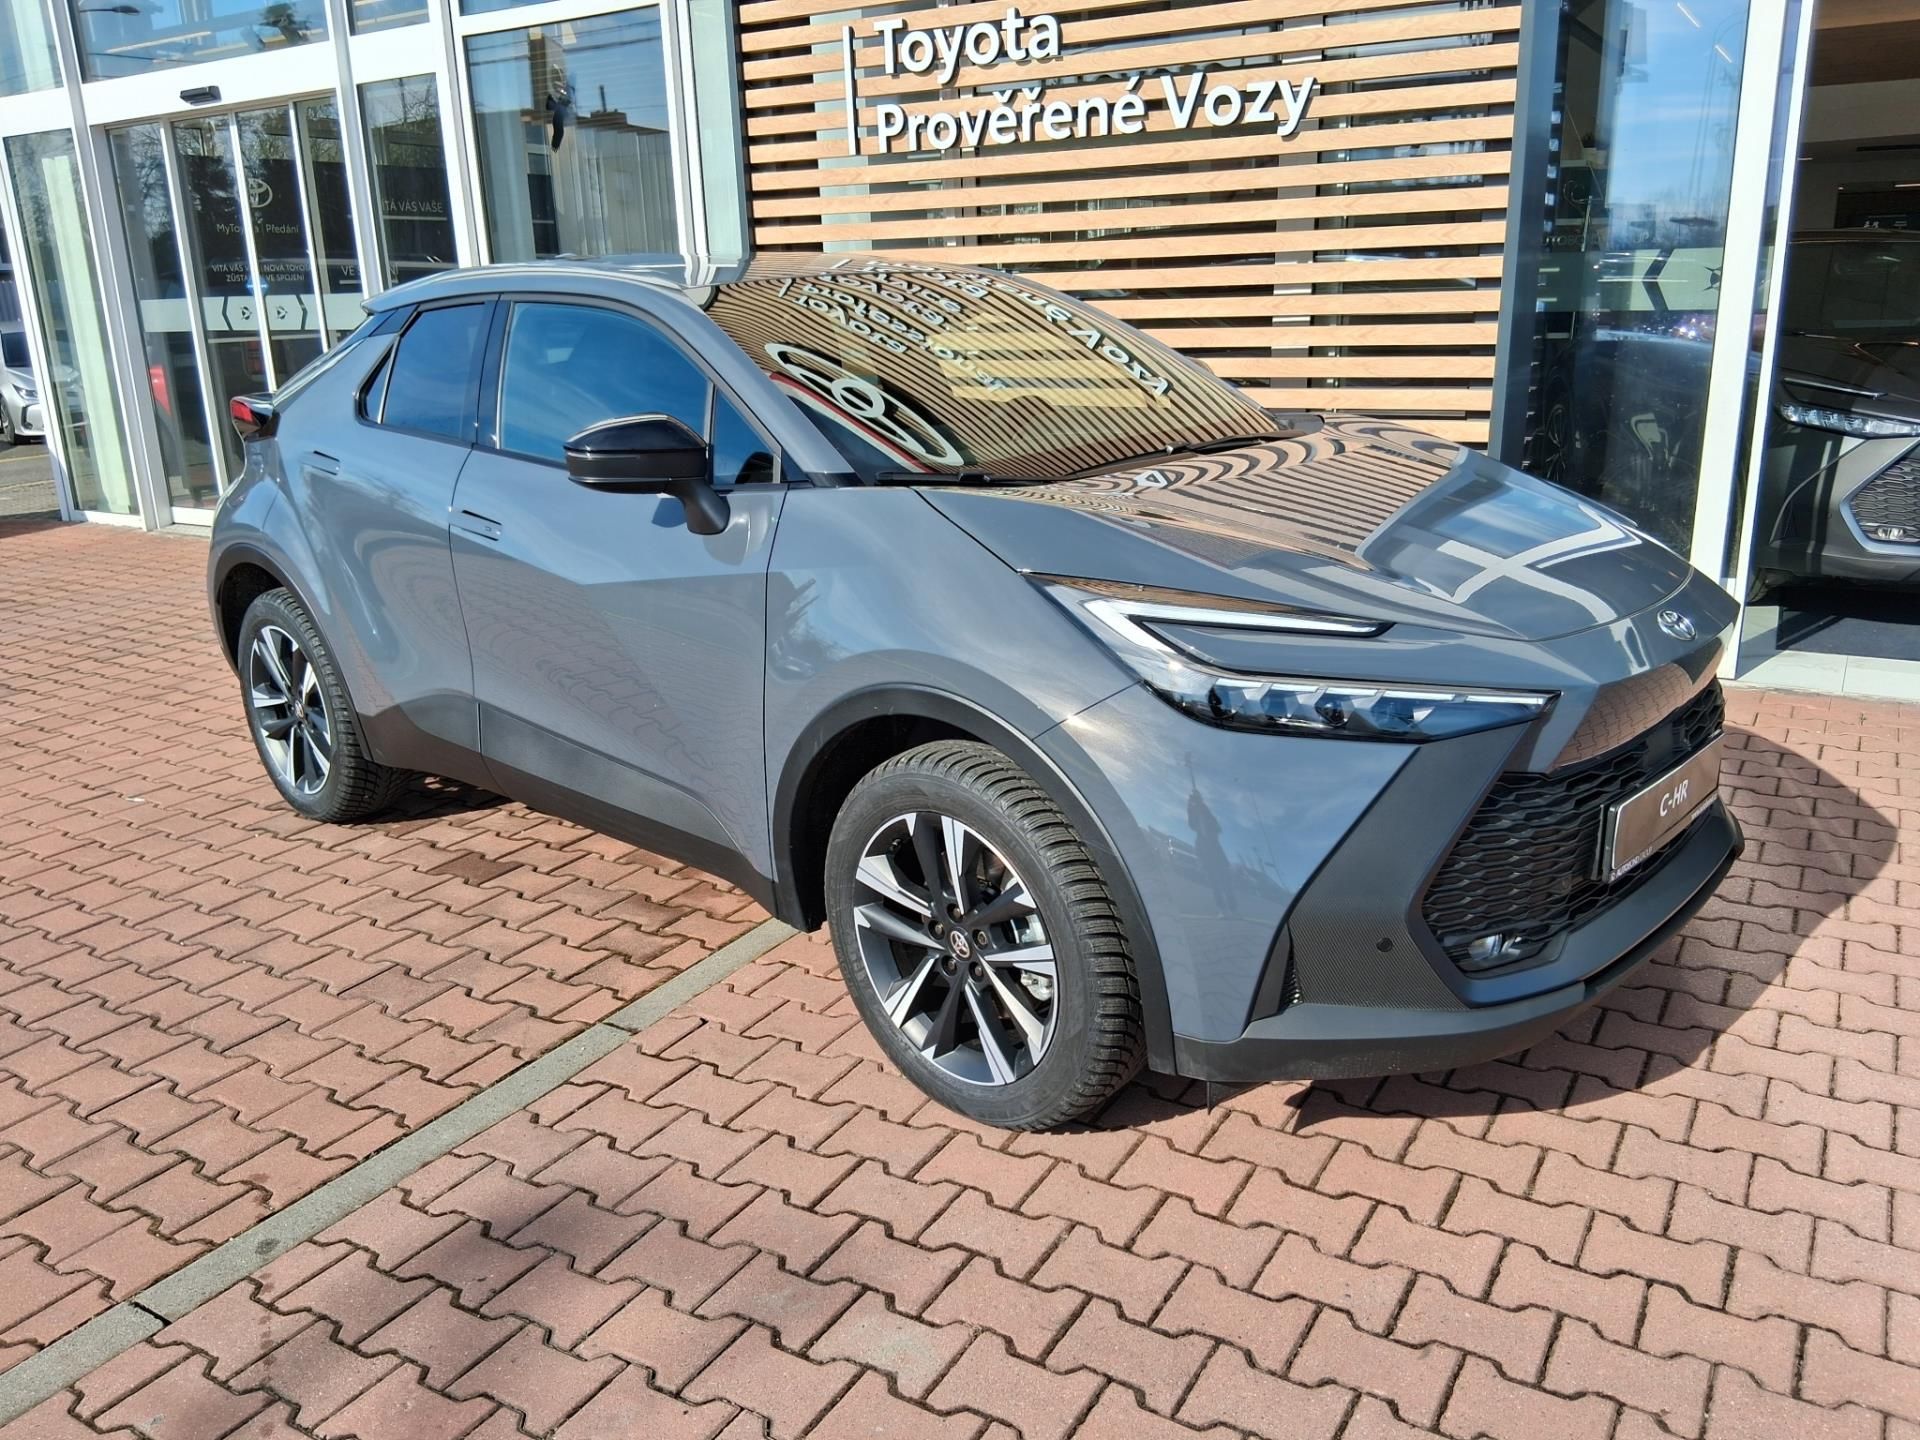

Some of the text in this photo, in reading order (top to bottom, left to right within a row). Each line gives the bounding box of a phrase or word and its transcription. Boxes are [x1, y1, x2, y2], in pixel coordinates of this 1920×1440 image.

[873, 7, 1061, 84] Toyota
[875, 71, 1318, 154] Prověřené Vozy
[1659, 779, 1689, 818] C-HR
